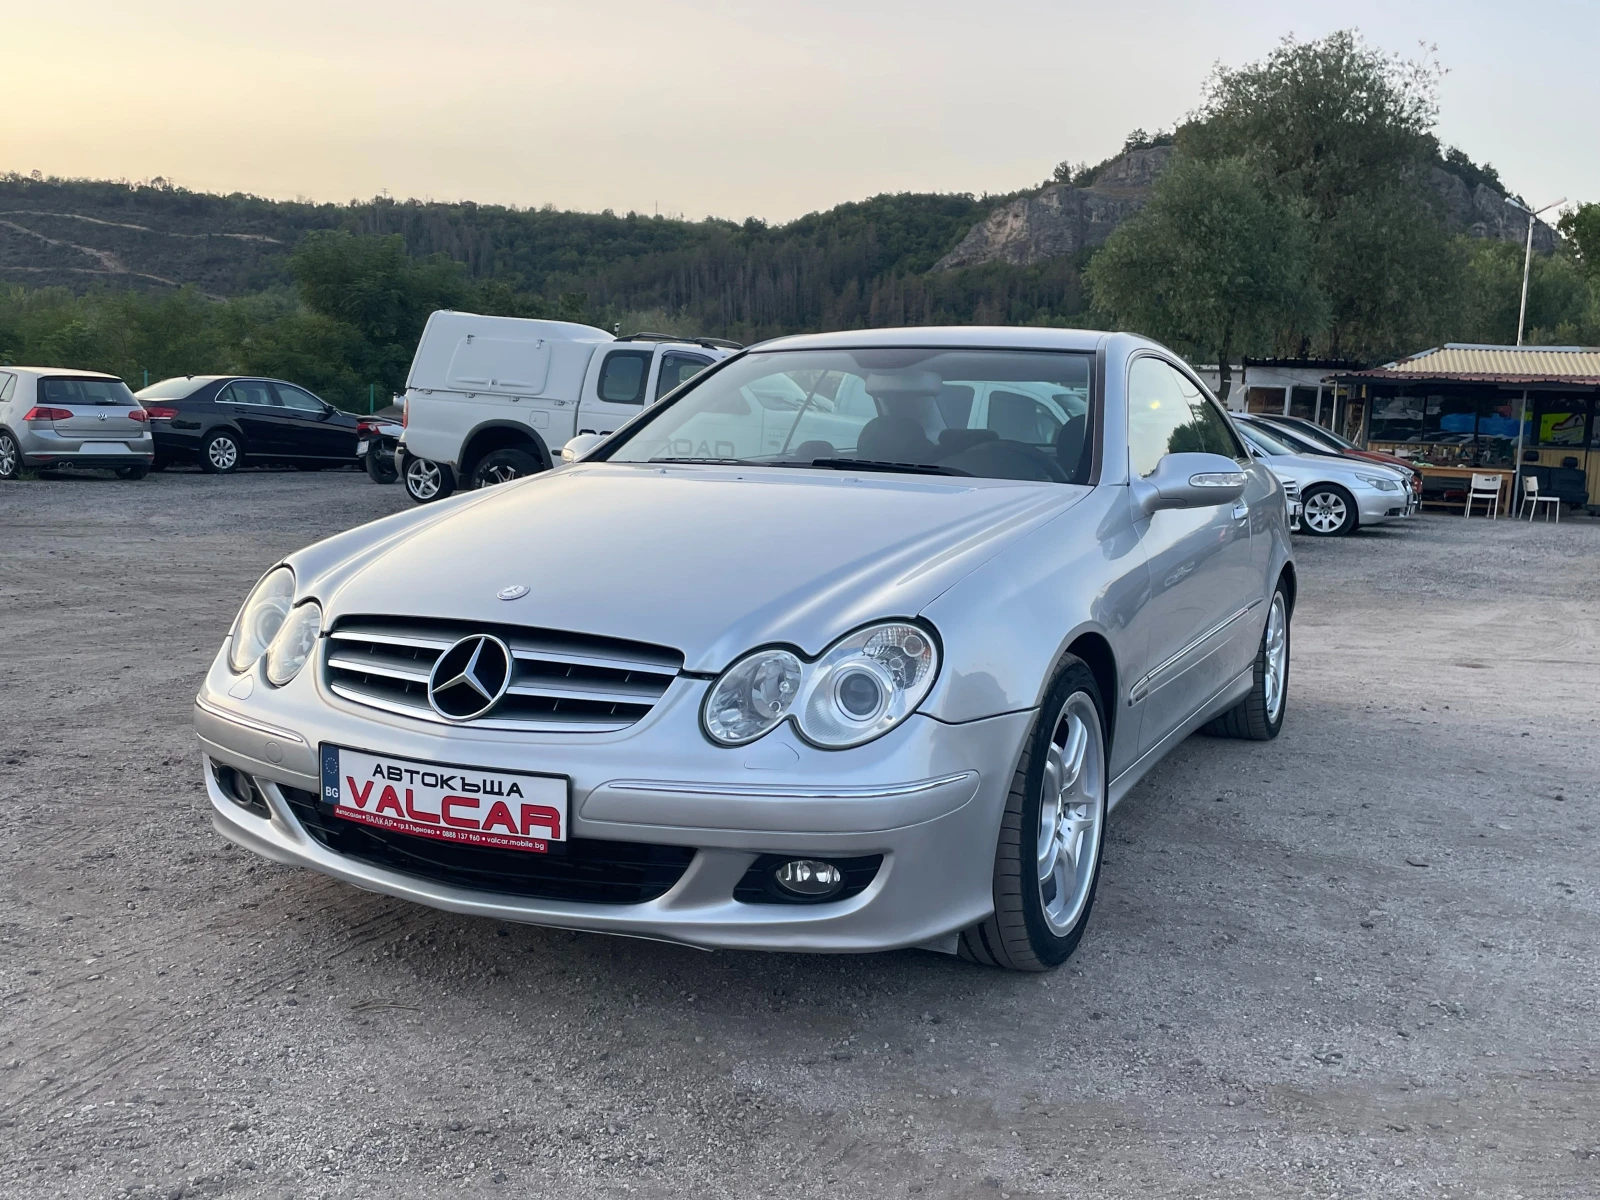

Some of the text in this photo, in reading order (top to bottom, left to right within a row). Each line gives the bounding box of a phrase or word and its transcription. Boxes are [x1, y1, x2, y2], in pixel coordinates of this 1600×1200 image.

[325, 786, 339, 798] BG
[372, 763, 524, 798] АВТОКЪЩА
[346, 776, 560, 839] VALCAR
[366, 814, 394, 827] ВАЛКАР
[458, 832, 468, 840] 137
[487, 837, 545, 850] valcar.mobile.bg
